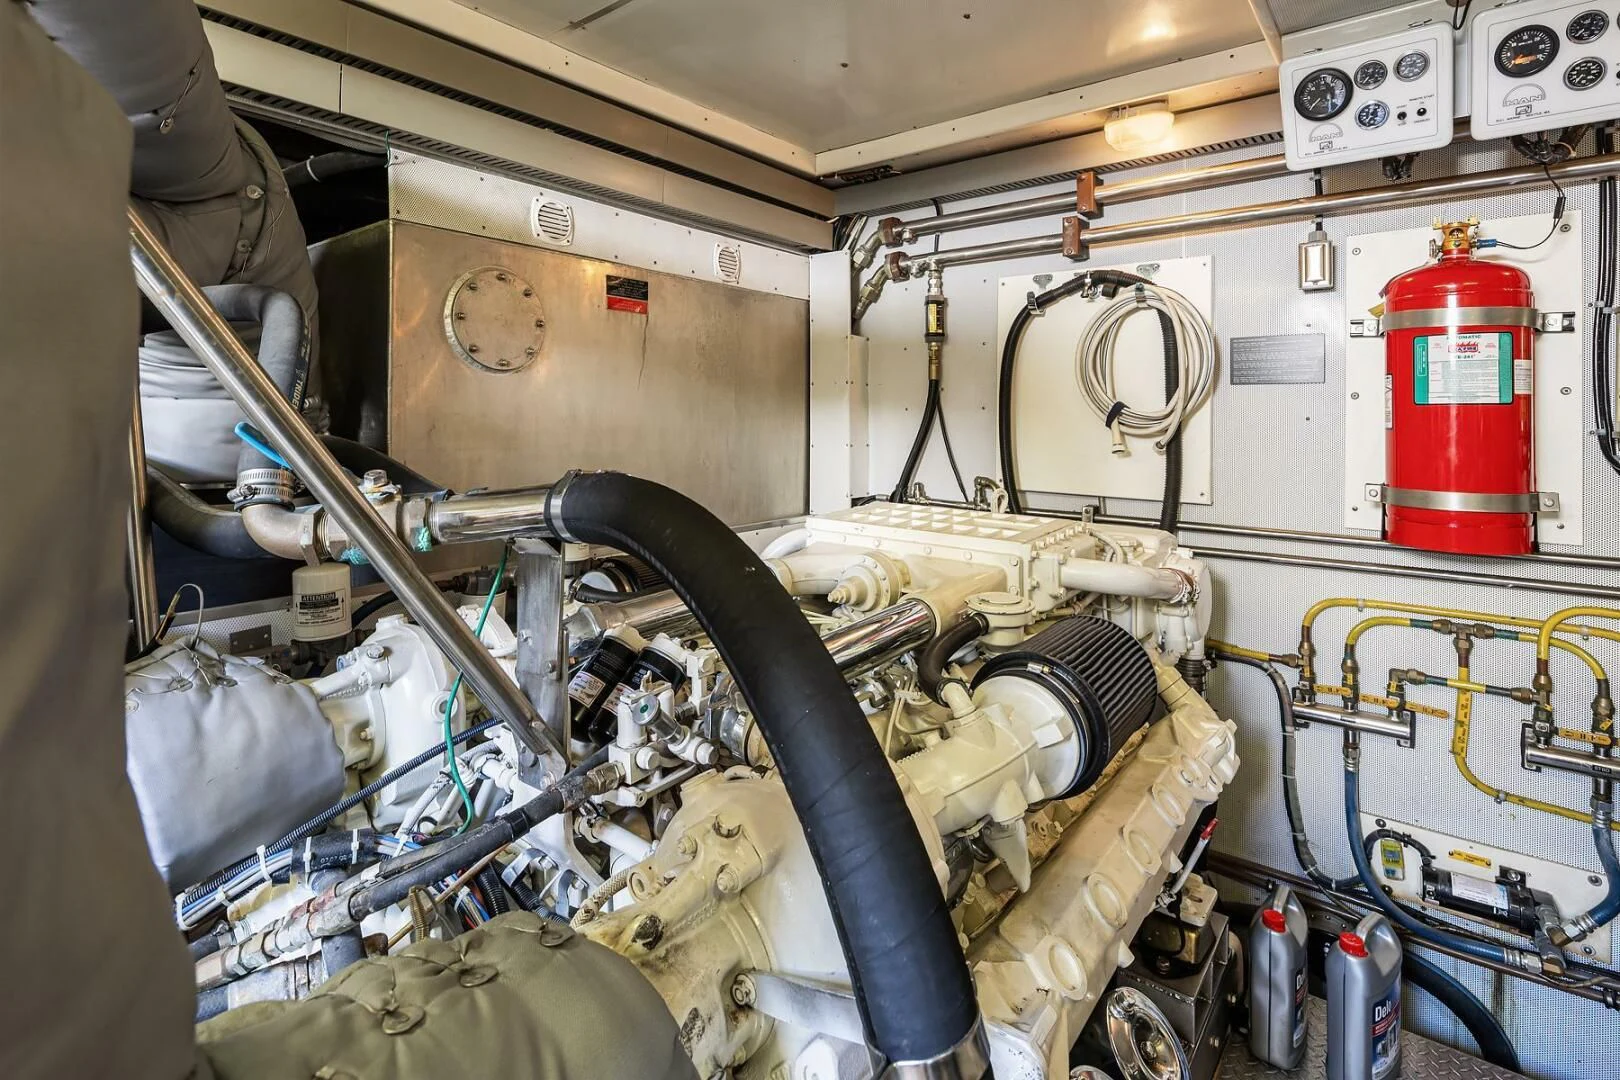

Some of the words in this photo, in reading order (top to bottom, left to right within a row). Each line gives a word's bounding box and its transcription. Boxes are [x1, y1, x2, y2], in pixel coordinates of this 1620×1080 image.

[1503, 94, 1543, 107] MAN
[292, 379, 304, 409] TRIDE
[301, 592, 336, 601] ATTENTION
